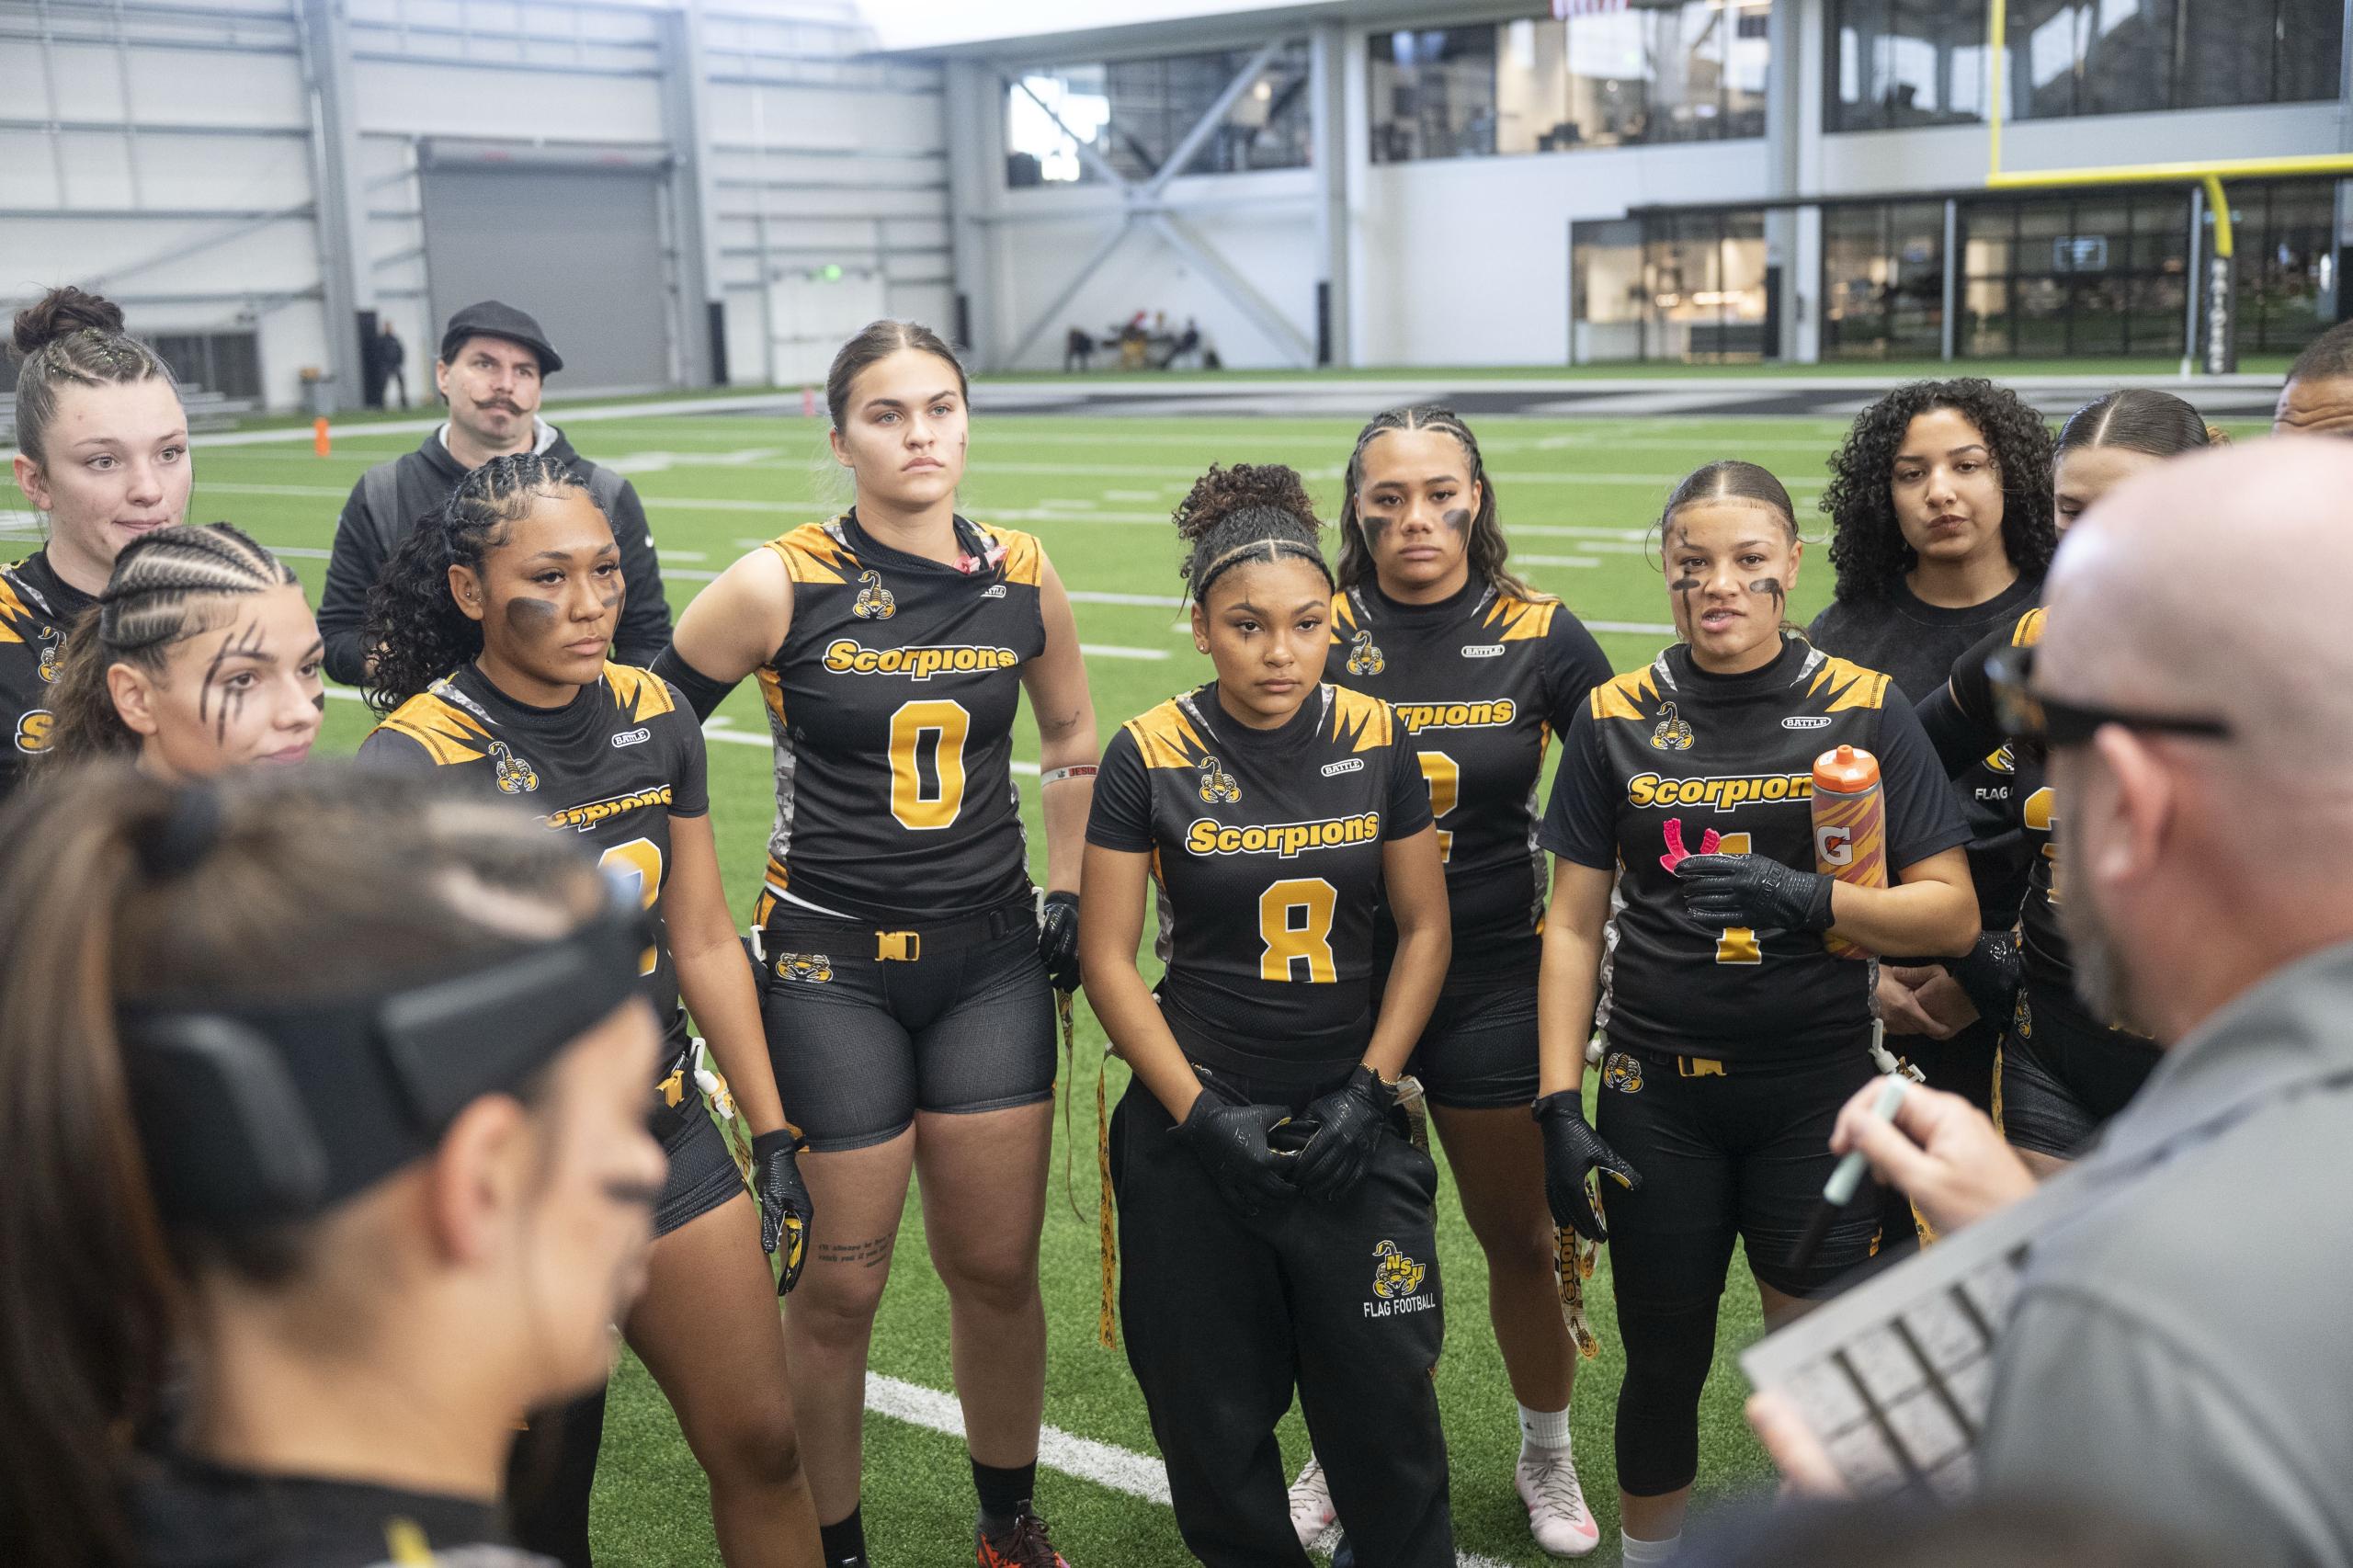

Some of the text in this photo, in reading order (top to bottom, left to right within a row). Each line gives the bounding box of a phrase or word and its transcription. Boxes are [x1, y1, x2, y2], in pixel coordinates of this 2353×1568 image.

[823, 640, 1017, 681] Scorpions
[1465, 645, 1502, 656] BATTLE
[1393, 699, 1517, 735] rpions
[1785, 718, 1828, 728] BATTLE
[614, 731, 647, 746] BATTLE
[888, 699, 970, 830] 0
[1324, 760, 1360, 776] BATTLE
[1629, 772, 1813, 812] Scorpion
[1975, 786, 2008, 801] FLAG
[1186, 812, 1379, 858] Scorpions
[1816, 825, 1853, 866] G
[1259, 877, 1337, 983] 8
[1385, 1253, 1426, 1283] NSU
[1363, 1293, 1436, 1318] FLAG FOOTBALL
